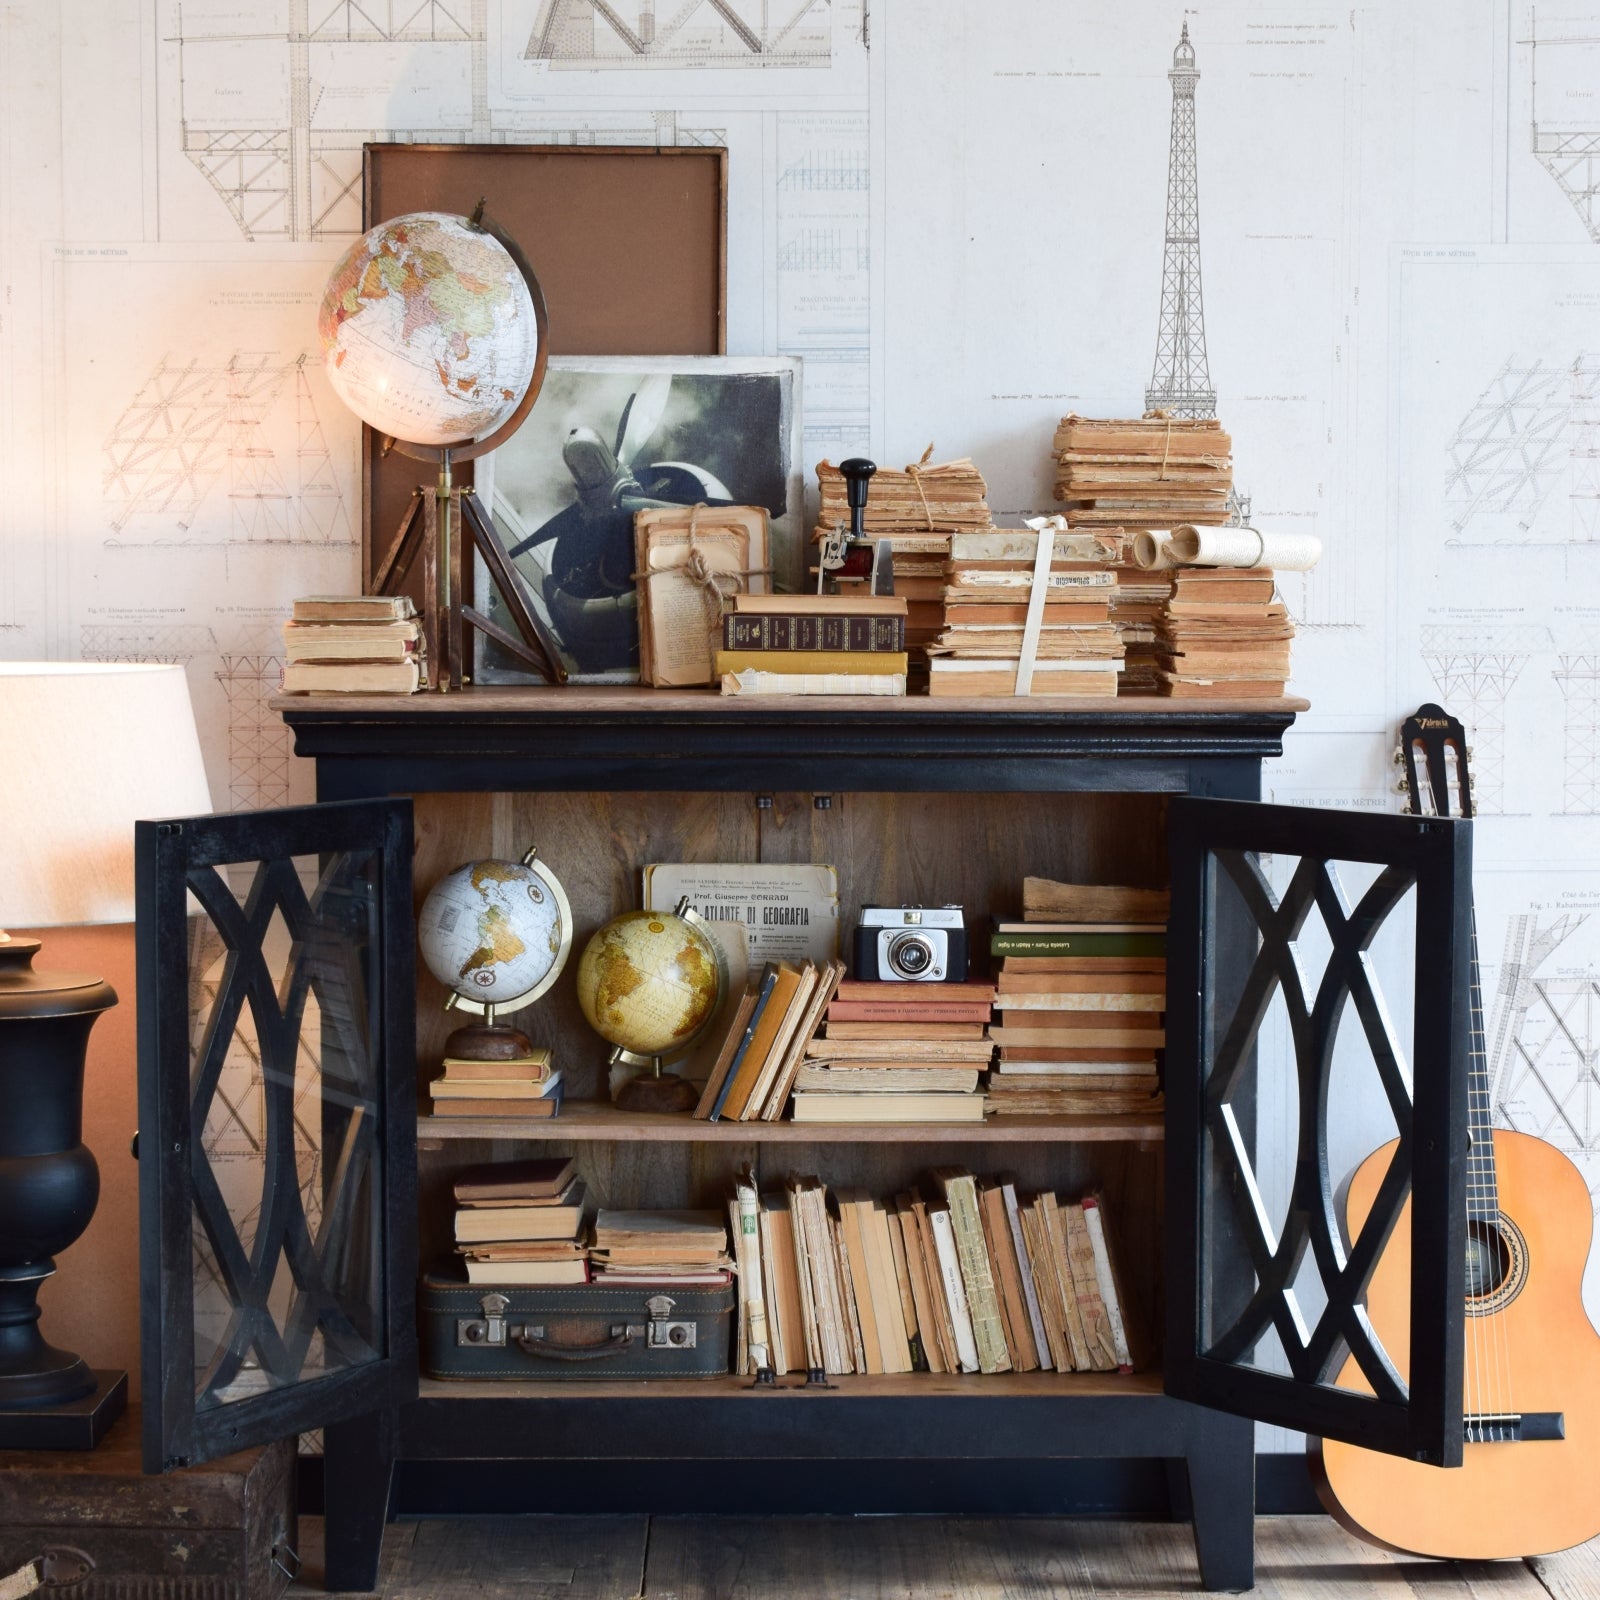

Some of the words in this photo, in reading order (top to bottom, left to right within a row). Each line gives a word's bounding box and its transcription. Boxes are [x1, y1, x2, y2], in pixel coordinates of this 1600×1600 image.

[1414, 717, 1449, 730] Valencia
[1290, 798, 1316, 807] TOUR
[1319, 798, 1332, 807] DE
[694, 892, 712, 901] Prof.
[750, 894, 789, 902] CORRADI
[1530, 902, 1543, 910] Fig.
[747, 906, 756, 924] DI
[763, 906, 810, 926] GEOGRAFIA
